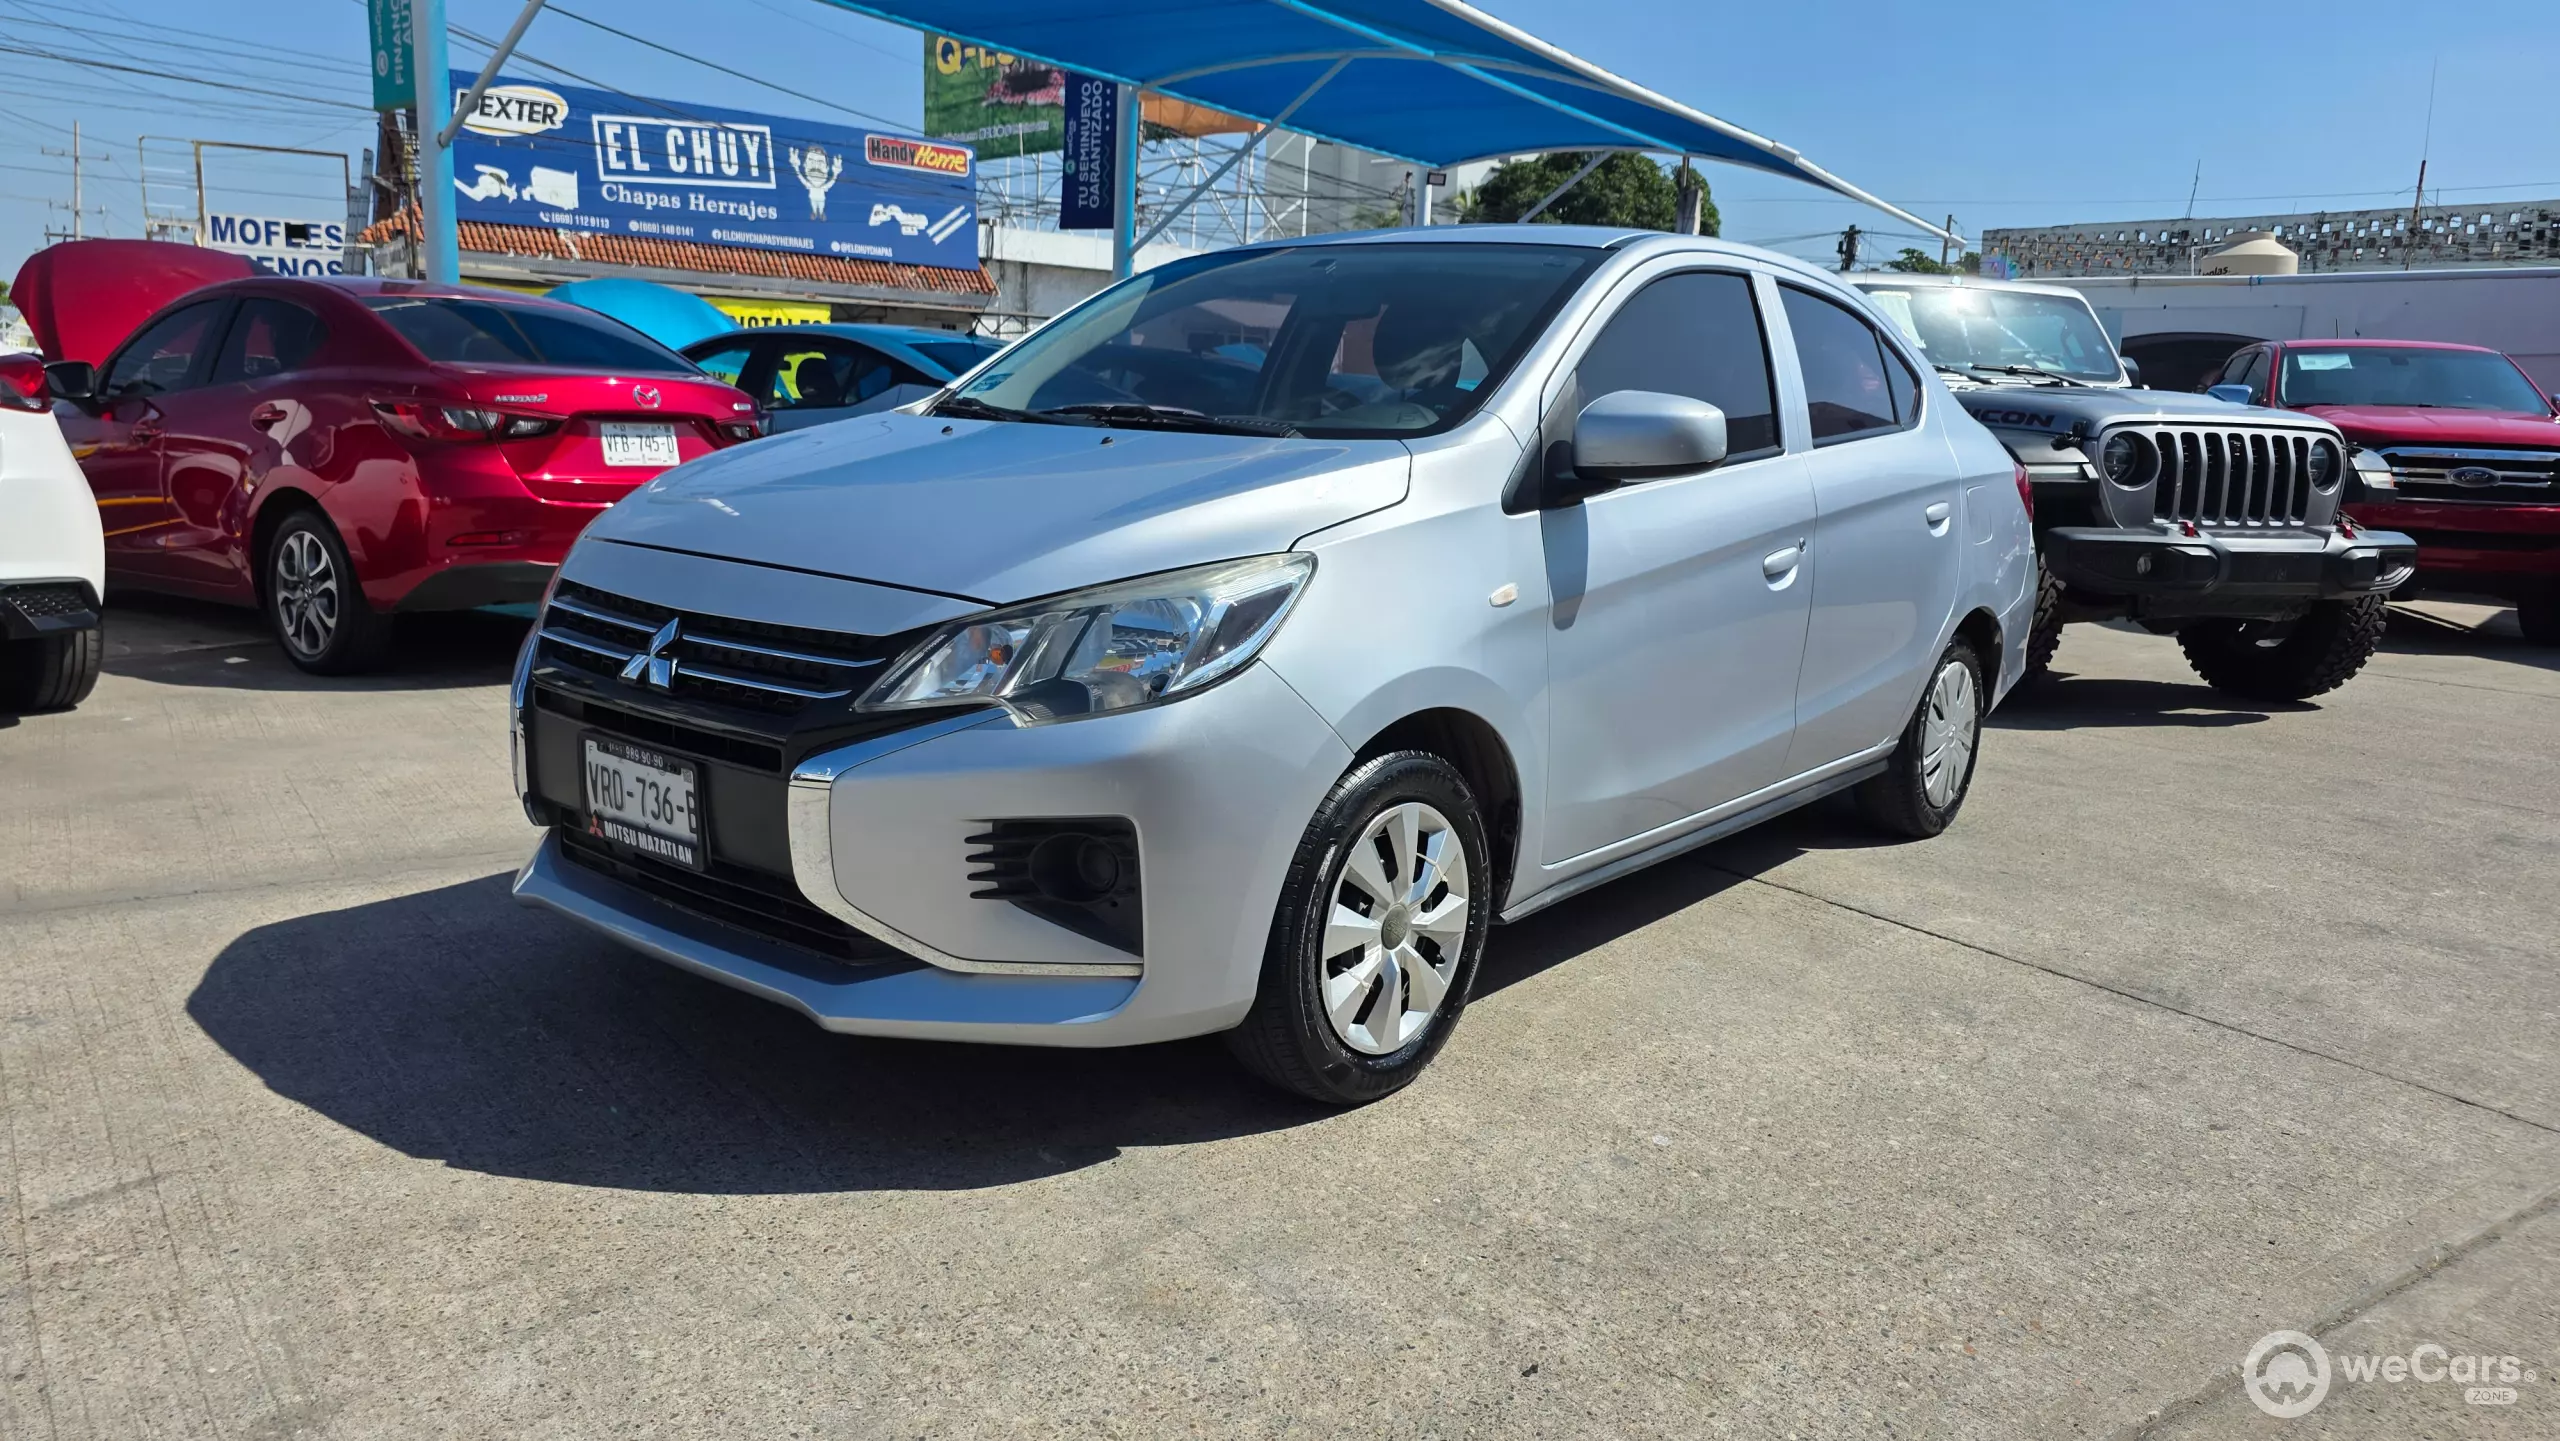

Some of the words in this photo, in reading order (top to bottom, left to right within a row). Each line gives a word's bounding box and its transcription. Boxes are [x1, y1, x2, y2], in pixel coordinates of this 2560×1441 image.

[604, 122, 650, 171] EL
[666, 127, 760, 177] CHUY
[1079, 82, 1092, 182] SEMINUEVO
[1089, 80, 1103, 209] GARANTIZADO
[602, 183, 681, 210] Chapas
[688, 192, 778, 220] Herrajes
[1078, 186, 1089, 208] TU
[605, 433, 675, 453] VFB-745-D
[604, 820, 637, 846] MITSU
[638, 831, 692, 865] MAZATLAN
